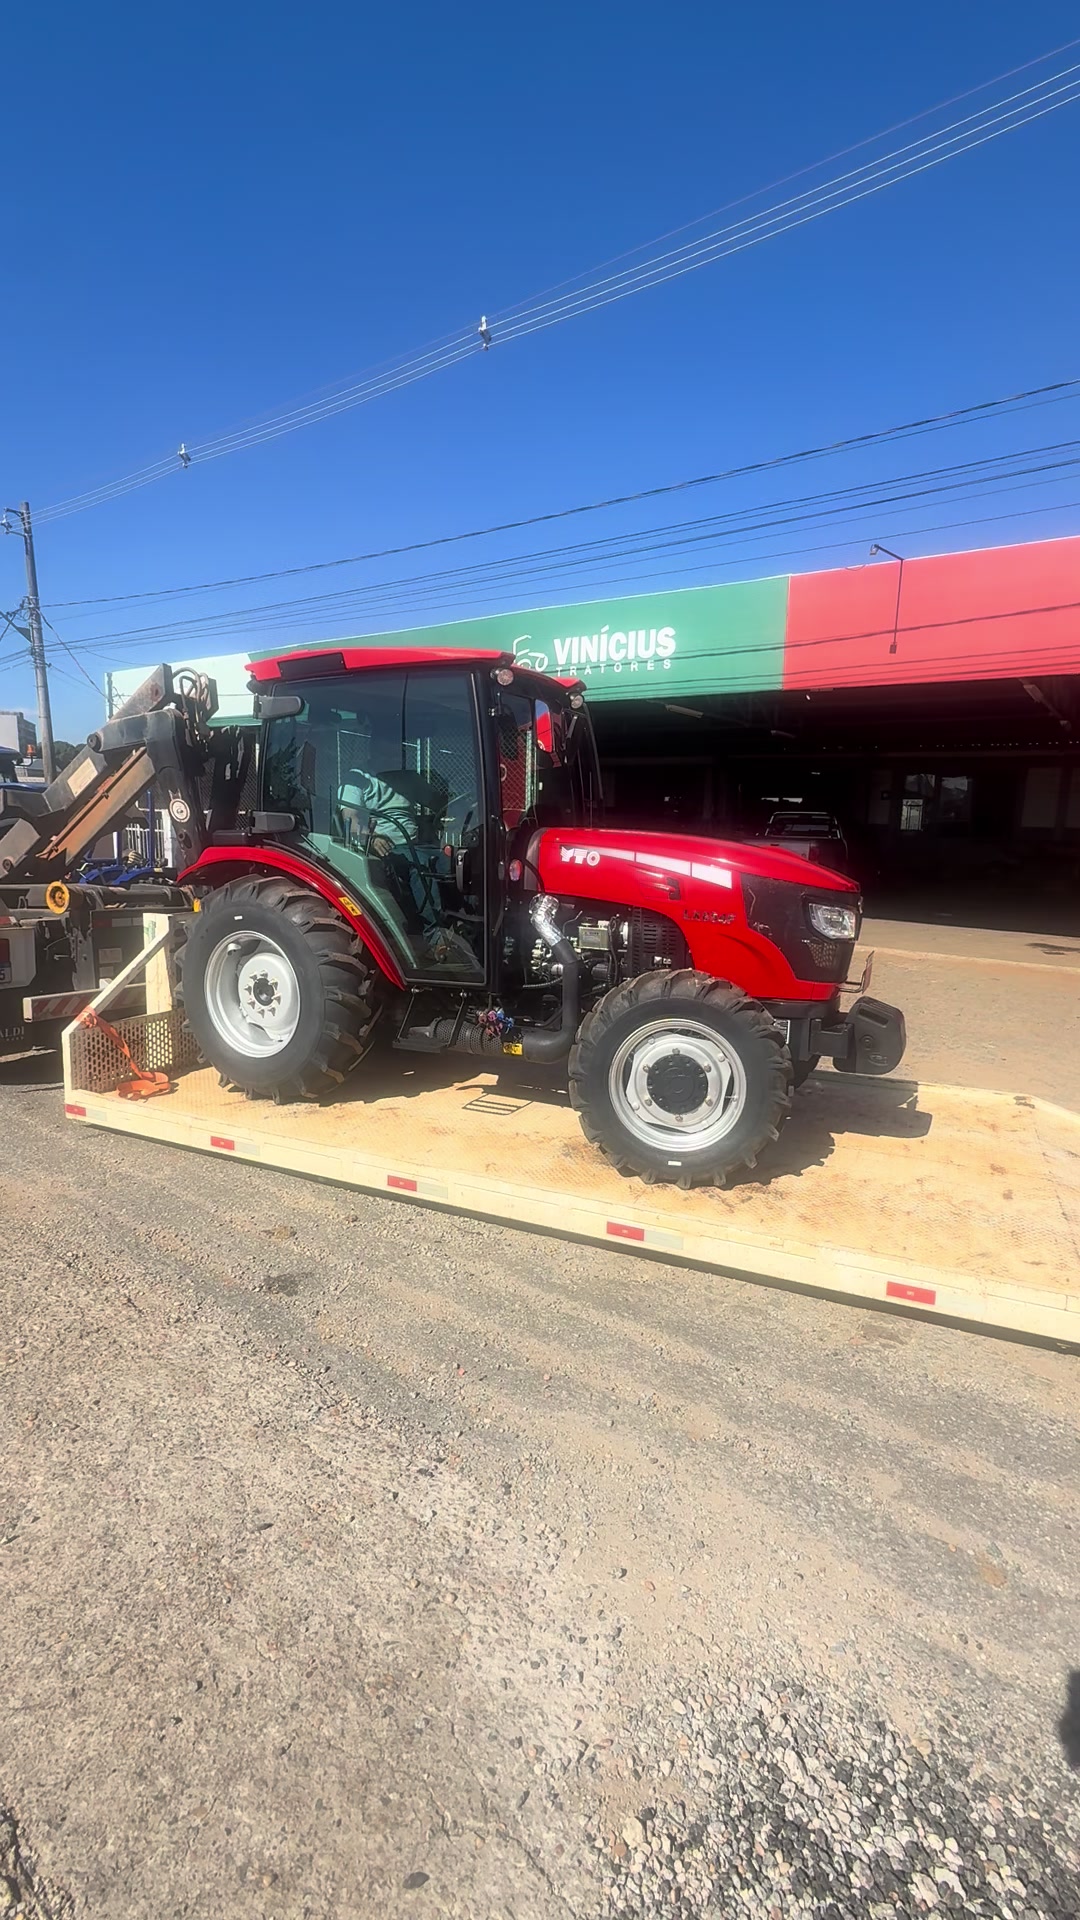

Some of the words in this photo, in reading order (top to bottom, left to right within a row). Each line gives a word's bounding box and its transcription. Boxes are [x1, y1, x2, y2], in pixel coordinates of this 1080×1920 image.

[553, 624, 676, 665] VINÍCIUS
[556, 659, 671, 677] TRATORES
[560, 846, 600, 866] YTO
